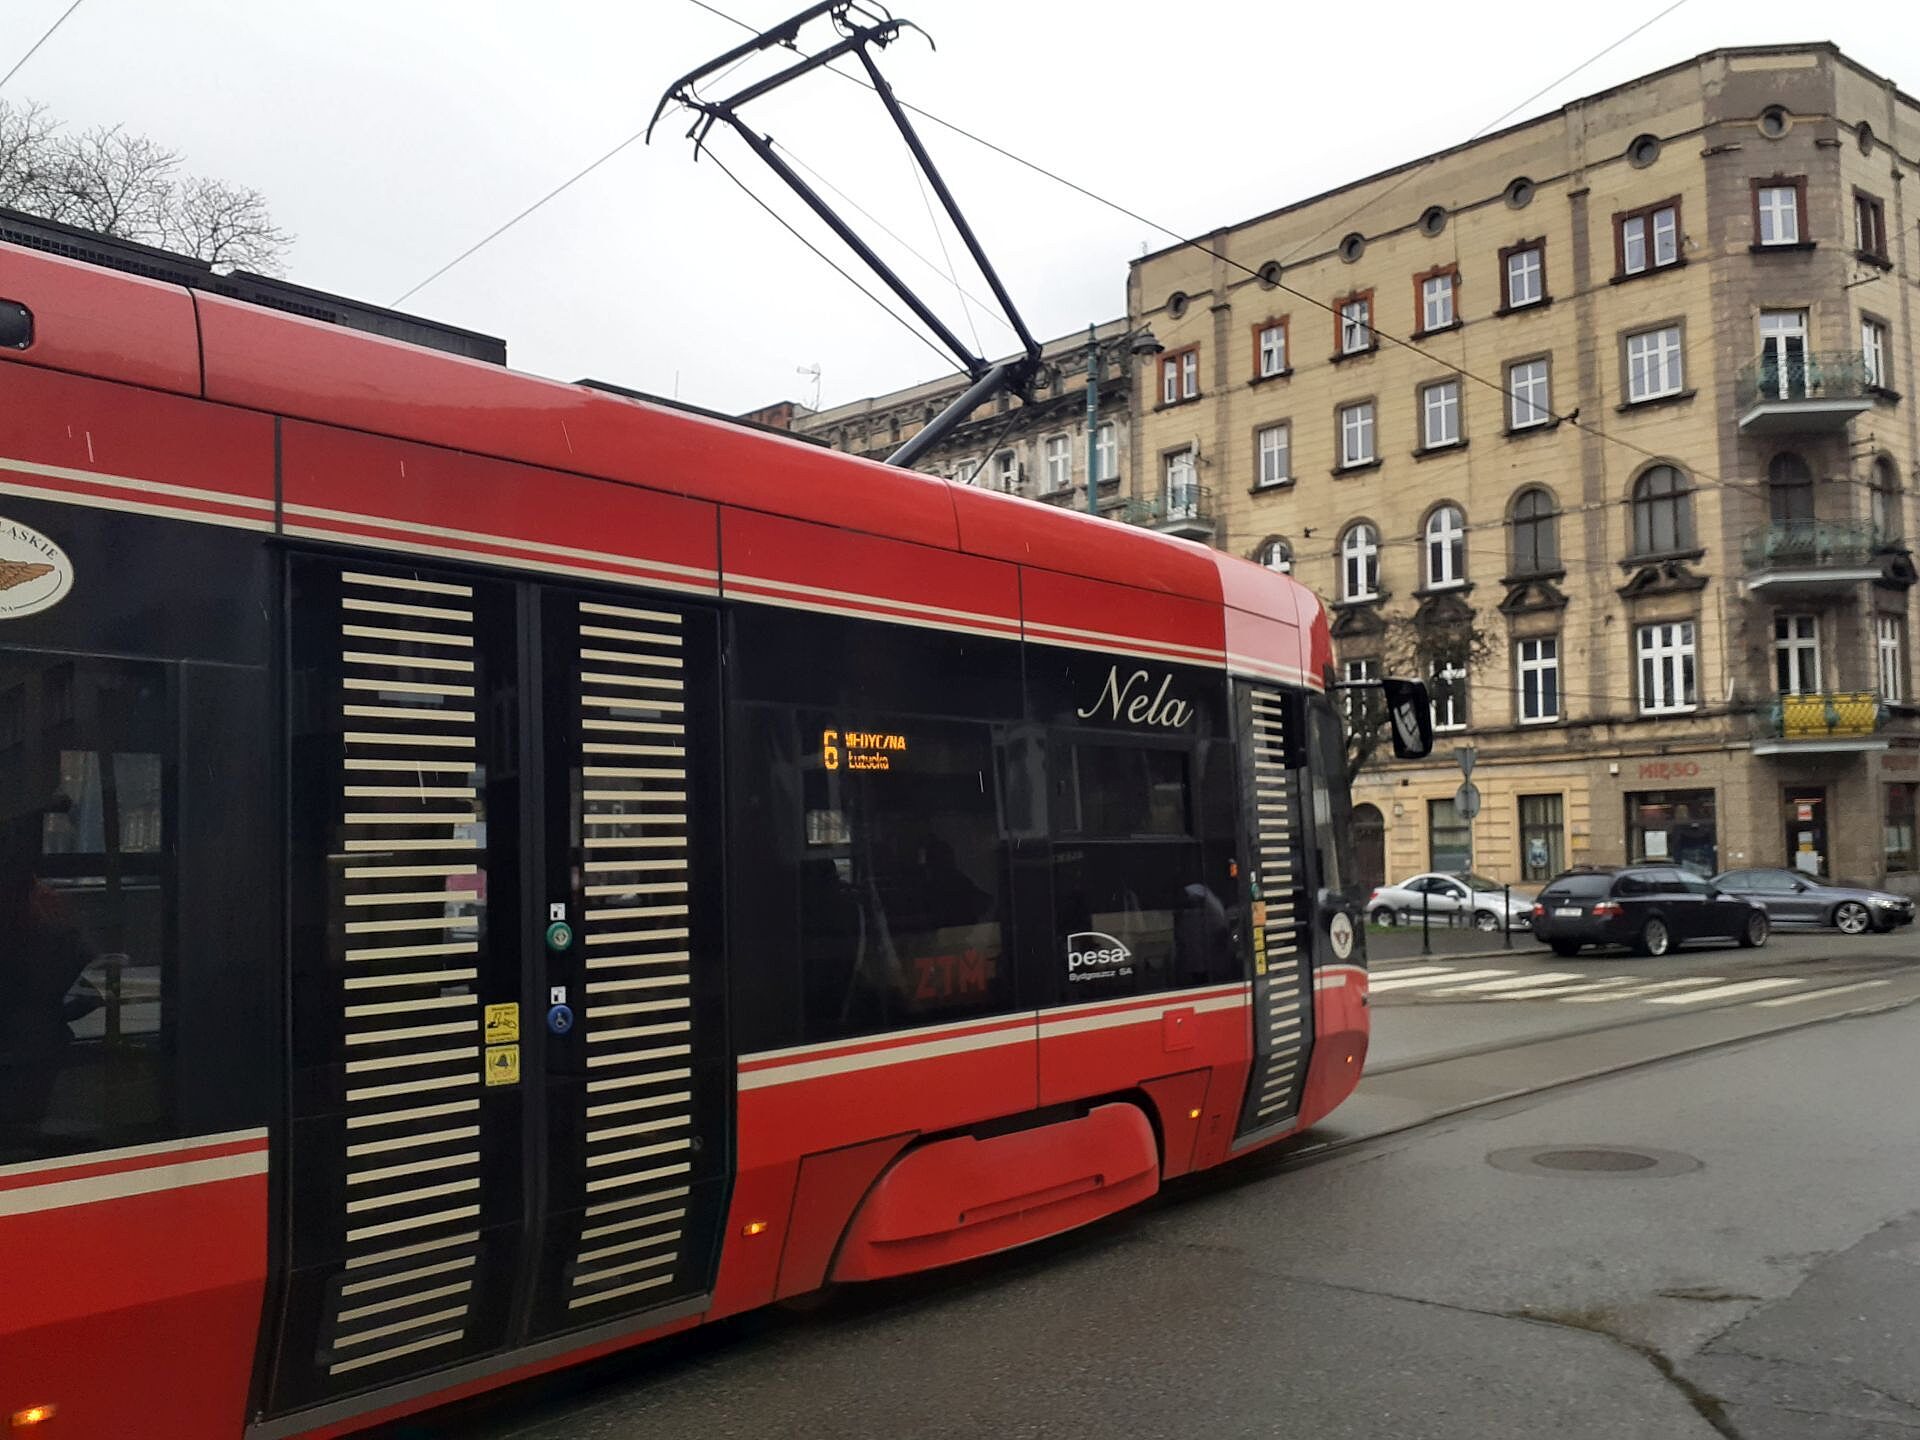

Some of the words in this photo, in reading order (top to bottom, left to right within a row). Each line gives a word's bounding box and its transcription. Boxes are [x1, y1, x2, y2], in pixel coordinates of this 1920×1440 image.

[1078, 665, 1194, 728] Nela
[823, 730, 839, 770] 6
[1068, 947, 1125, 972] pesa
